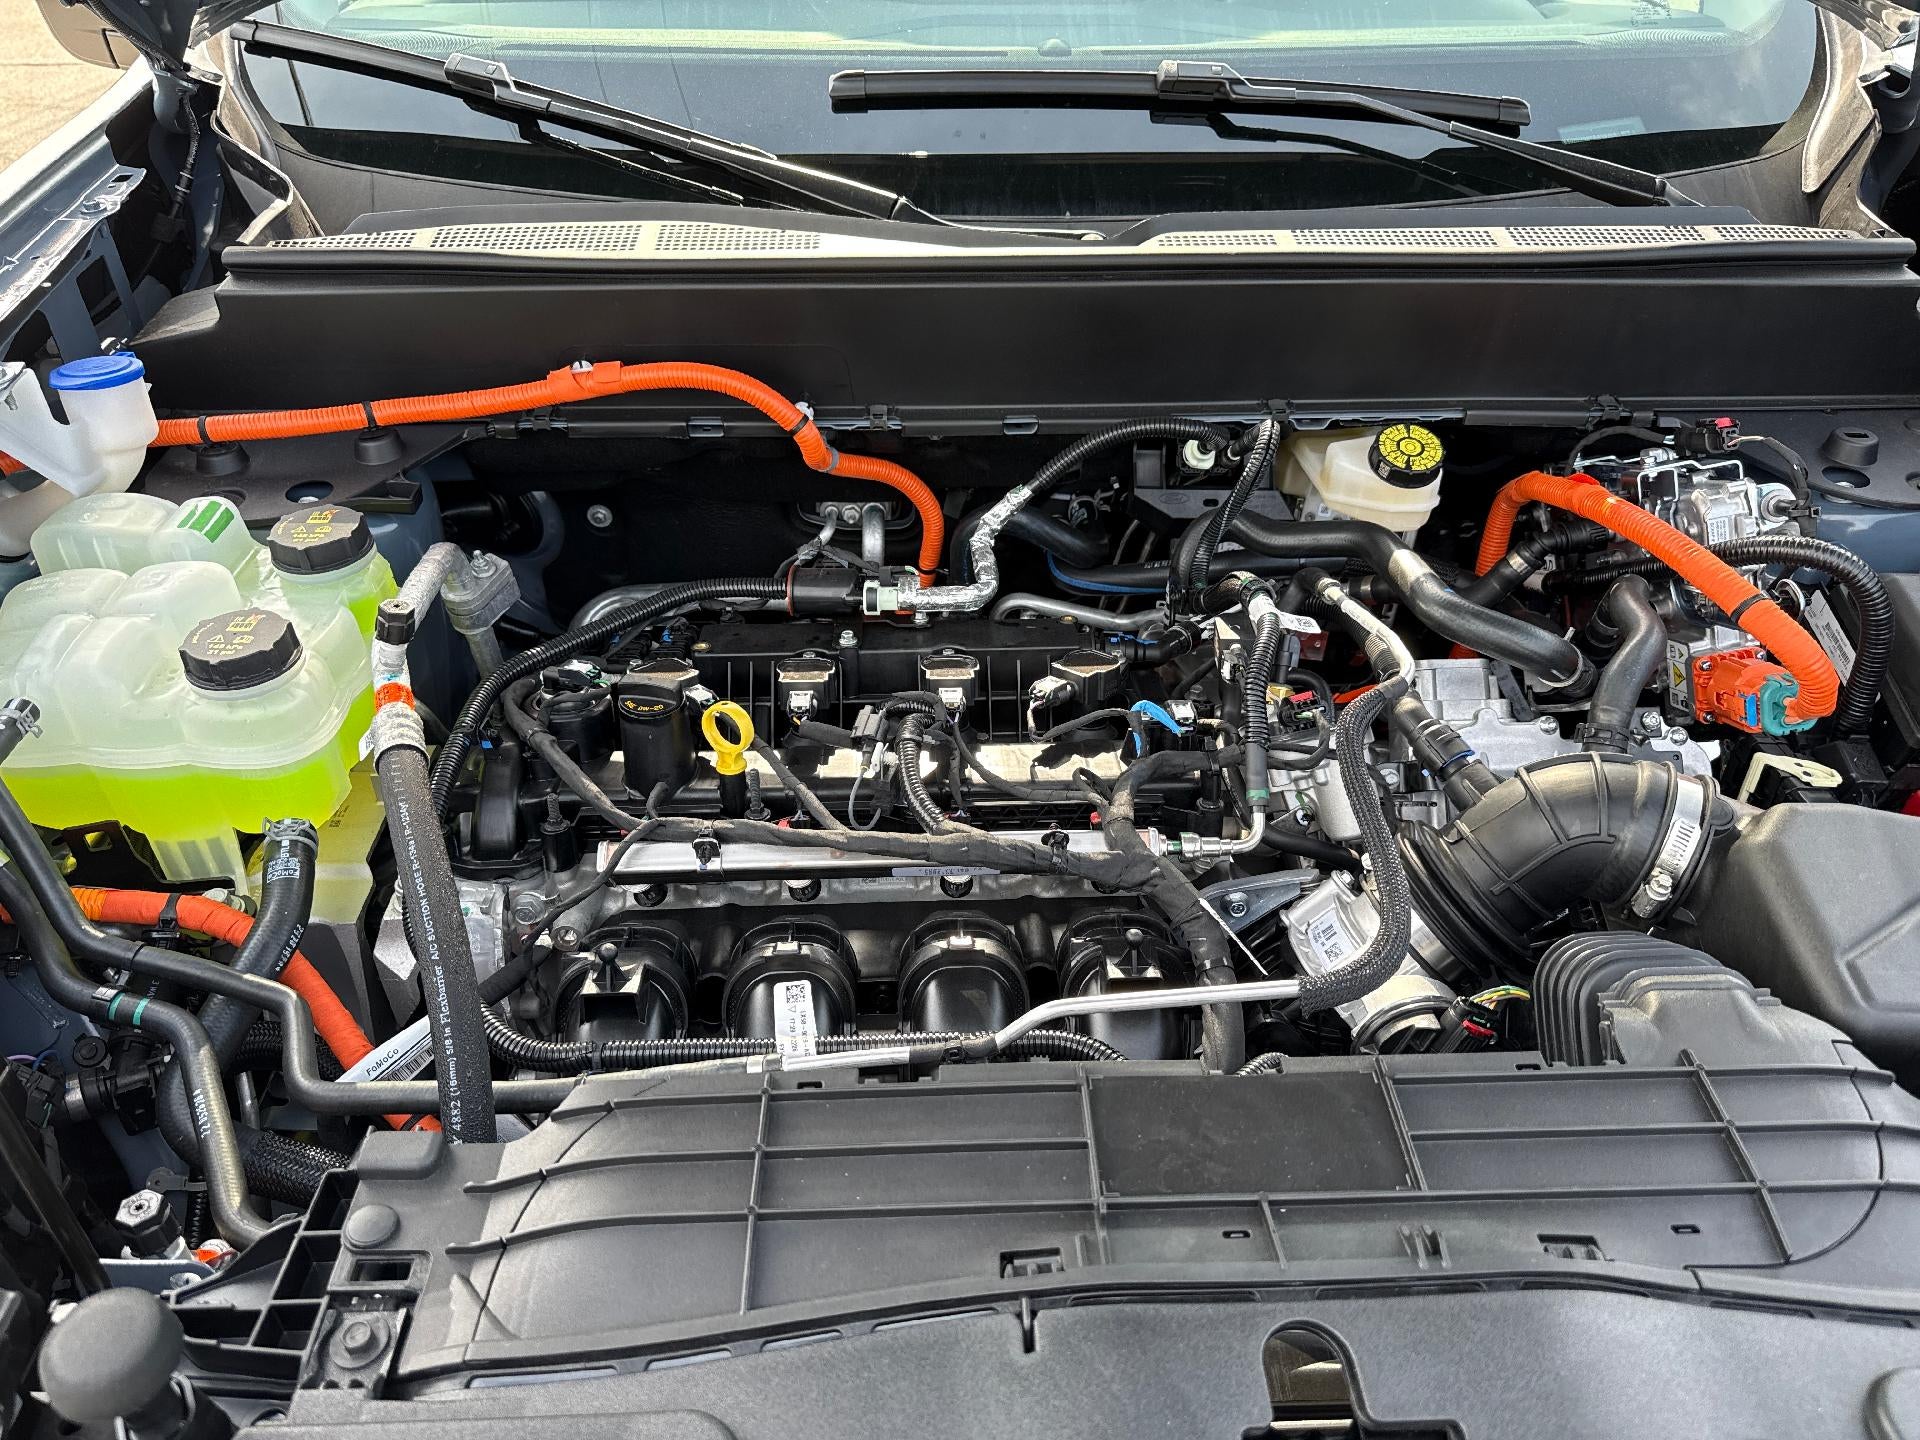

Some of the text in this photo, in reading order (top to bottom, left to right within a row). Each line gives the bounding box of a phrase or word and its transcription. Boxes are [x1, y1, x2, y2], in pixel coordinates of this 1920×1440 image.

[414, 871, 427, 897] HOSE
[420, 898, 436, 941] SUCTION
[365, 1048, 399, 1077] FoMoCo
[447, 1057, 461, 1096] (16mm)
[450, 1100, 462, 1131] 4882
